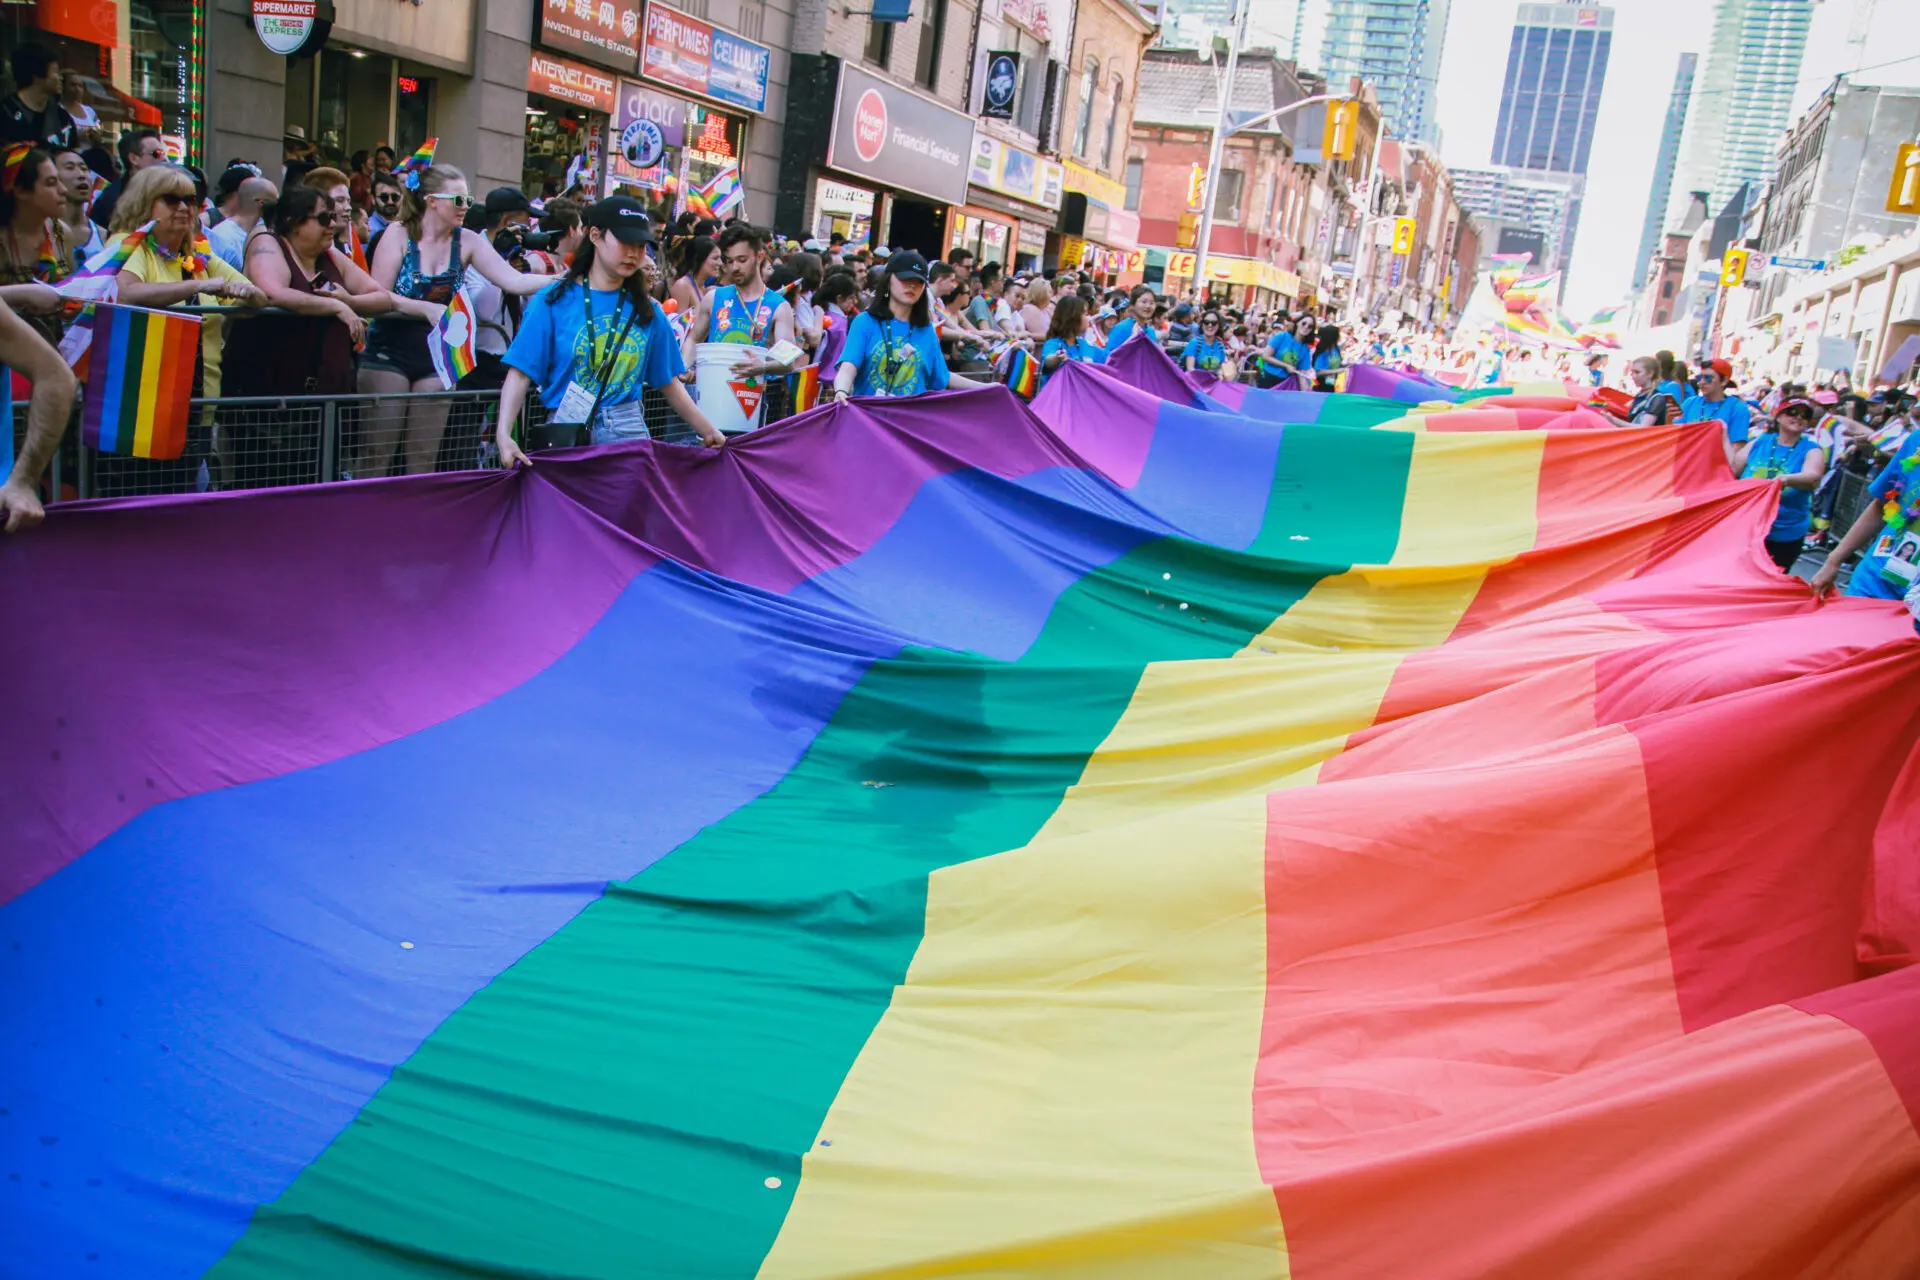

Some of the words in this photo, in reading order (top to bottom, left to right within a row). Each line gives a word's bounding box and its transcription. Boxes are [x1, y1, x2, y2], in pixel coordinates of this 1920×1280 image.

[253, 2, 316, 15] SUPERMARKET
[264, 18, 279, 26] THE
[264, 27, 303, 36] EXPRESS
[544, 17, 581, 38] INVICTUS
[582, 31, 605, 47] GAME
[606, 39, 637, 58] STATION
[648, 13, 710, 56] PERFUMES
[714, 38, 768, 77] CELLULAR
[399, 77, 418, 92] PEN
[532, 56, 582, 84] INTERNET
[583, 73, 613, 95] CAFE
[549, 83, 575, 98] SECOND
[575, 91, 597, 106] FLOOR
[628, 92, 676, 127] chatr
[860, 108, 884, 132] Money
[623, 122, 659, 144] PERFUMES
[860, 125, 879, 144] Mart
[892, 126, 931, 155] Financial
[930, 140, 960, 167] Services
[737, 390, 761, 399] CANADIAN
[744, 398, 755, 407] TIRE
